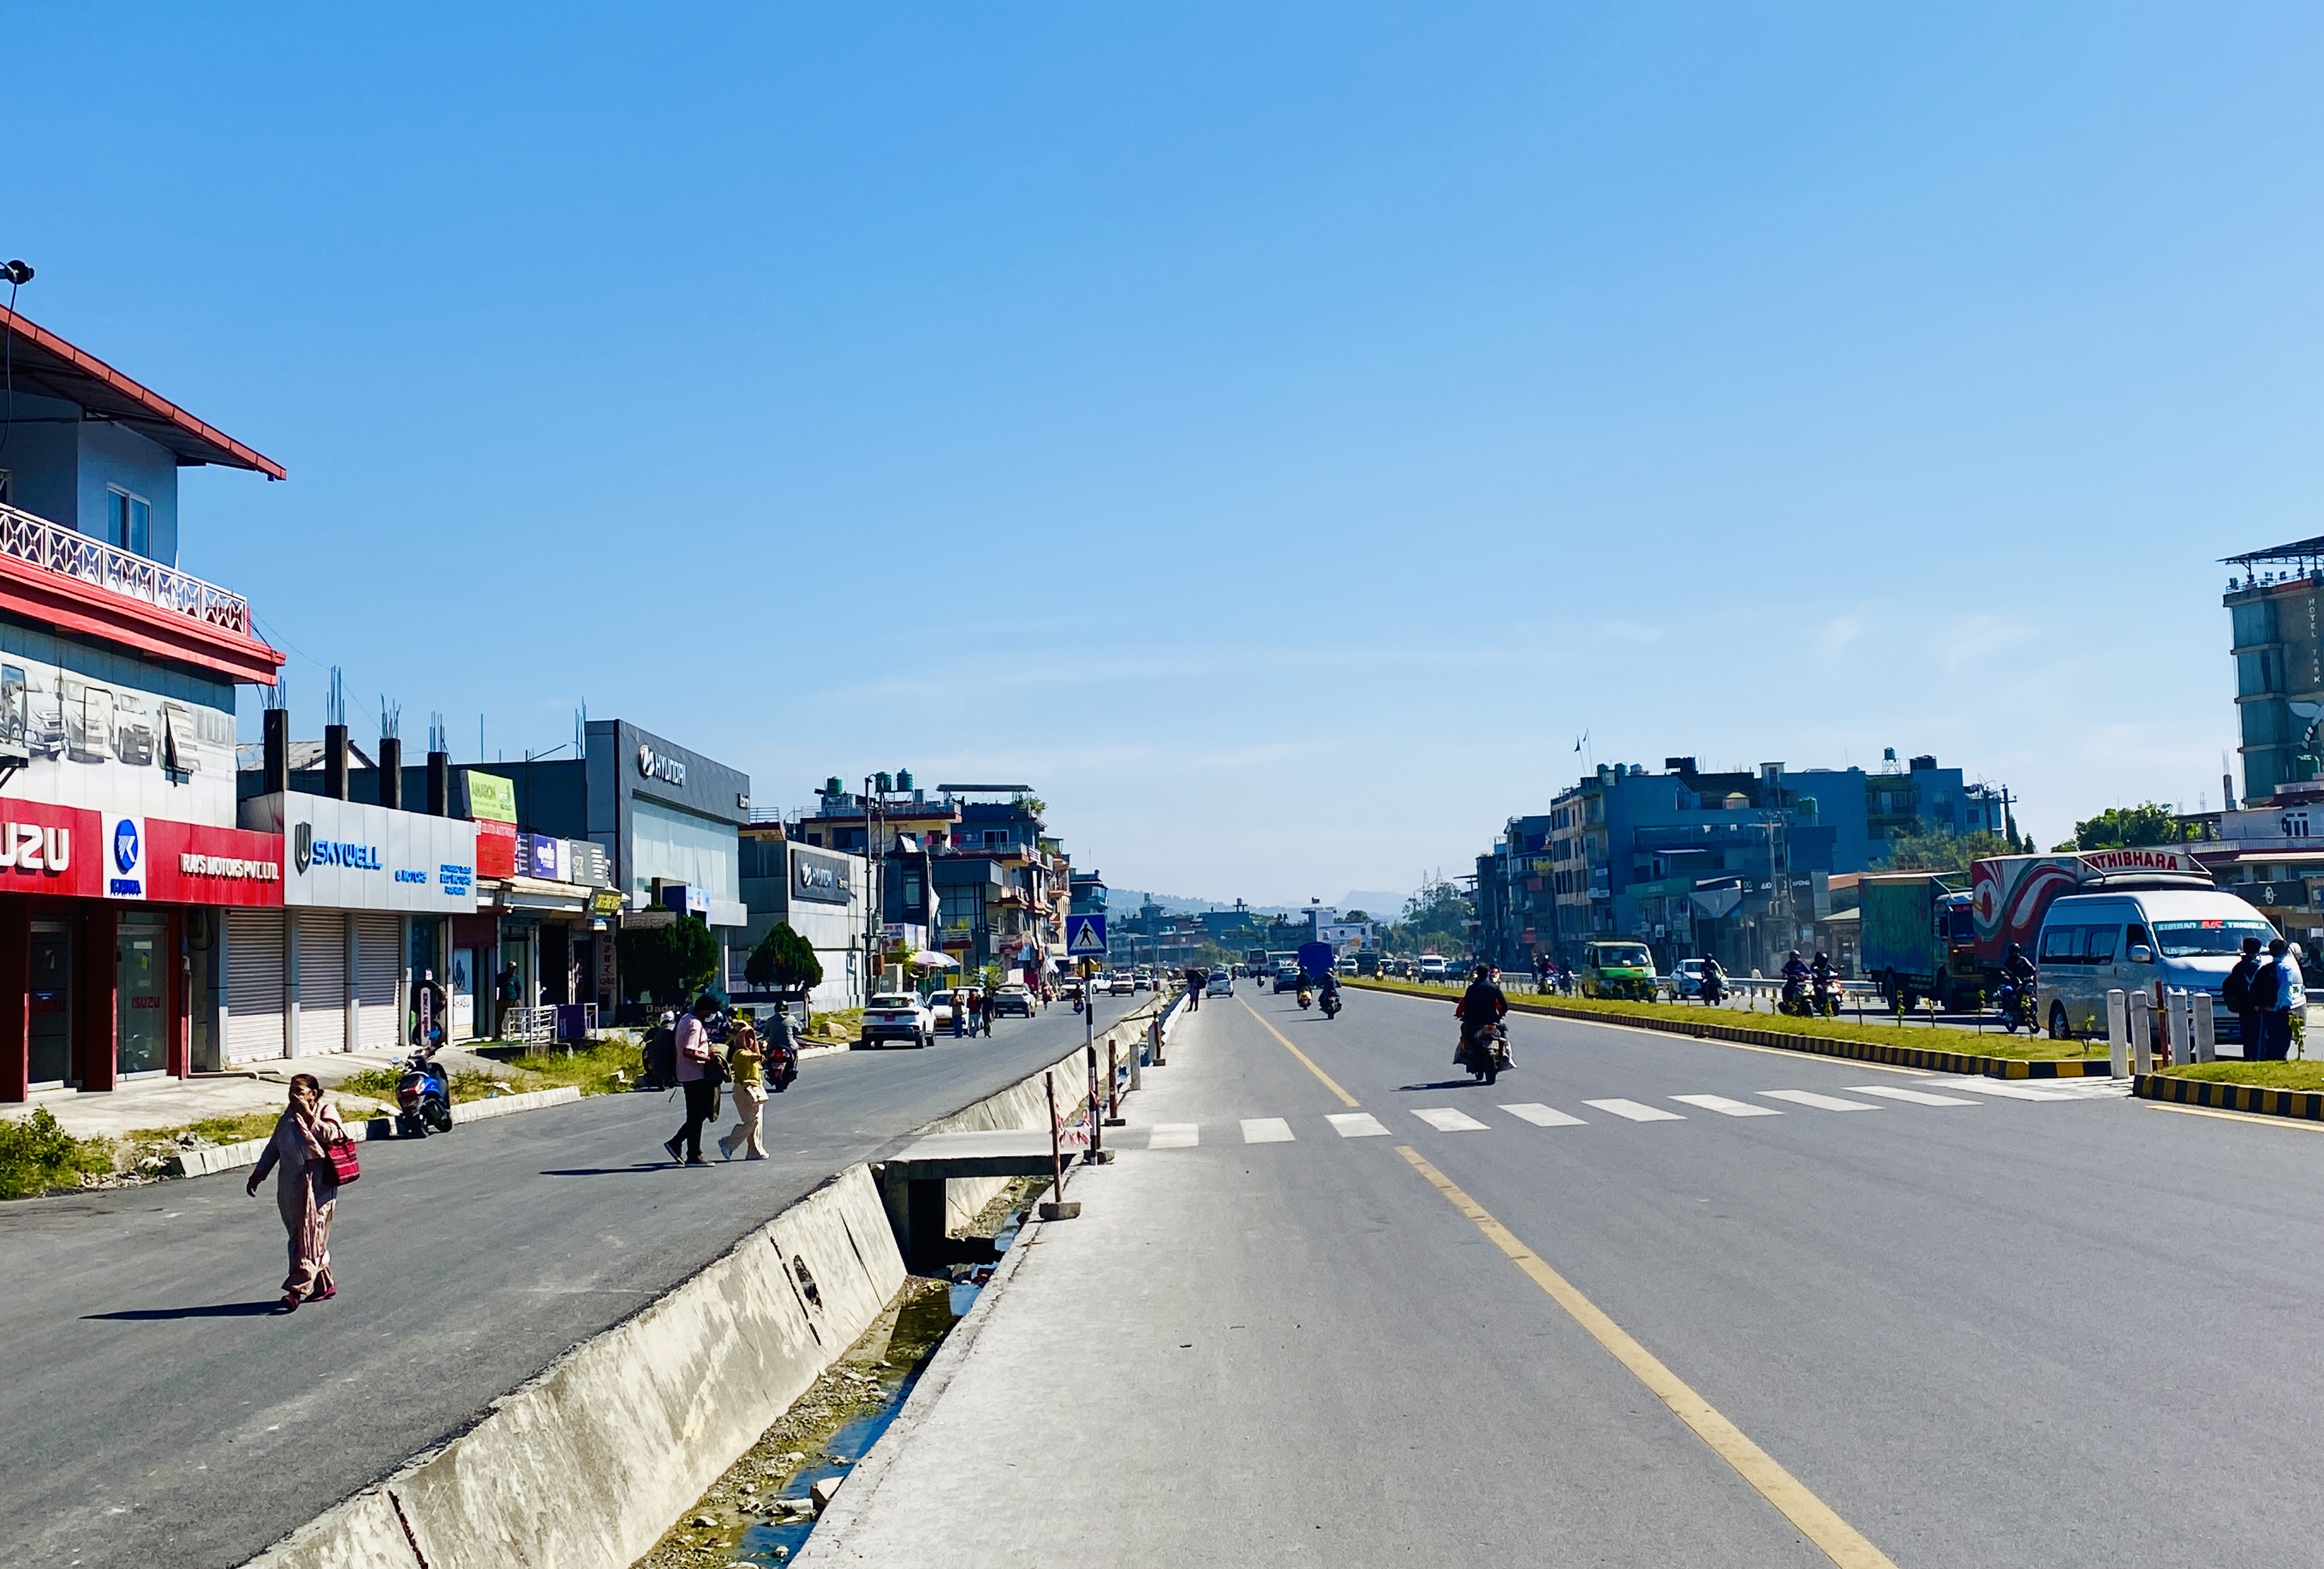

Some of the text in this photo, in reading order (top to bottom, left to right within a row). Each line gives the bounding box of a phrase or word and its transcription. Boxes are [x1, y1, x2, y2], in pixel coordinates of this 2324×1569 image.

[2308, 598, 2317, 638] HOTEL
[655, 753, 686, 786] HYUNDAI
[180, 853, 206, 874] RAYS
[207, 856, 244, 877] MOTORS
[131, 995, 160, 1009] ISUZU
